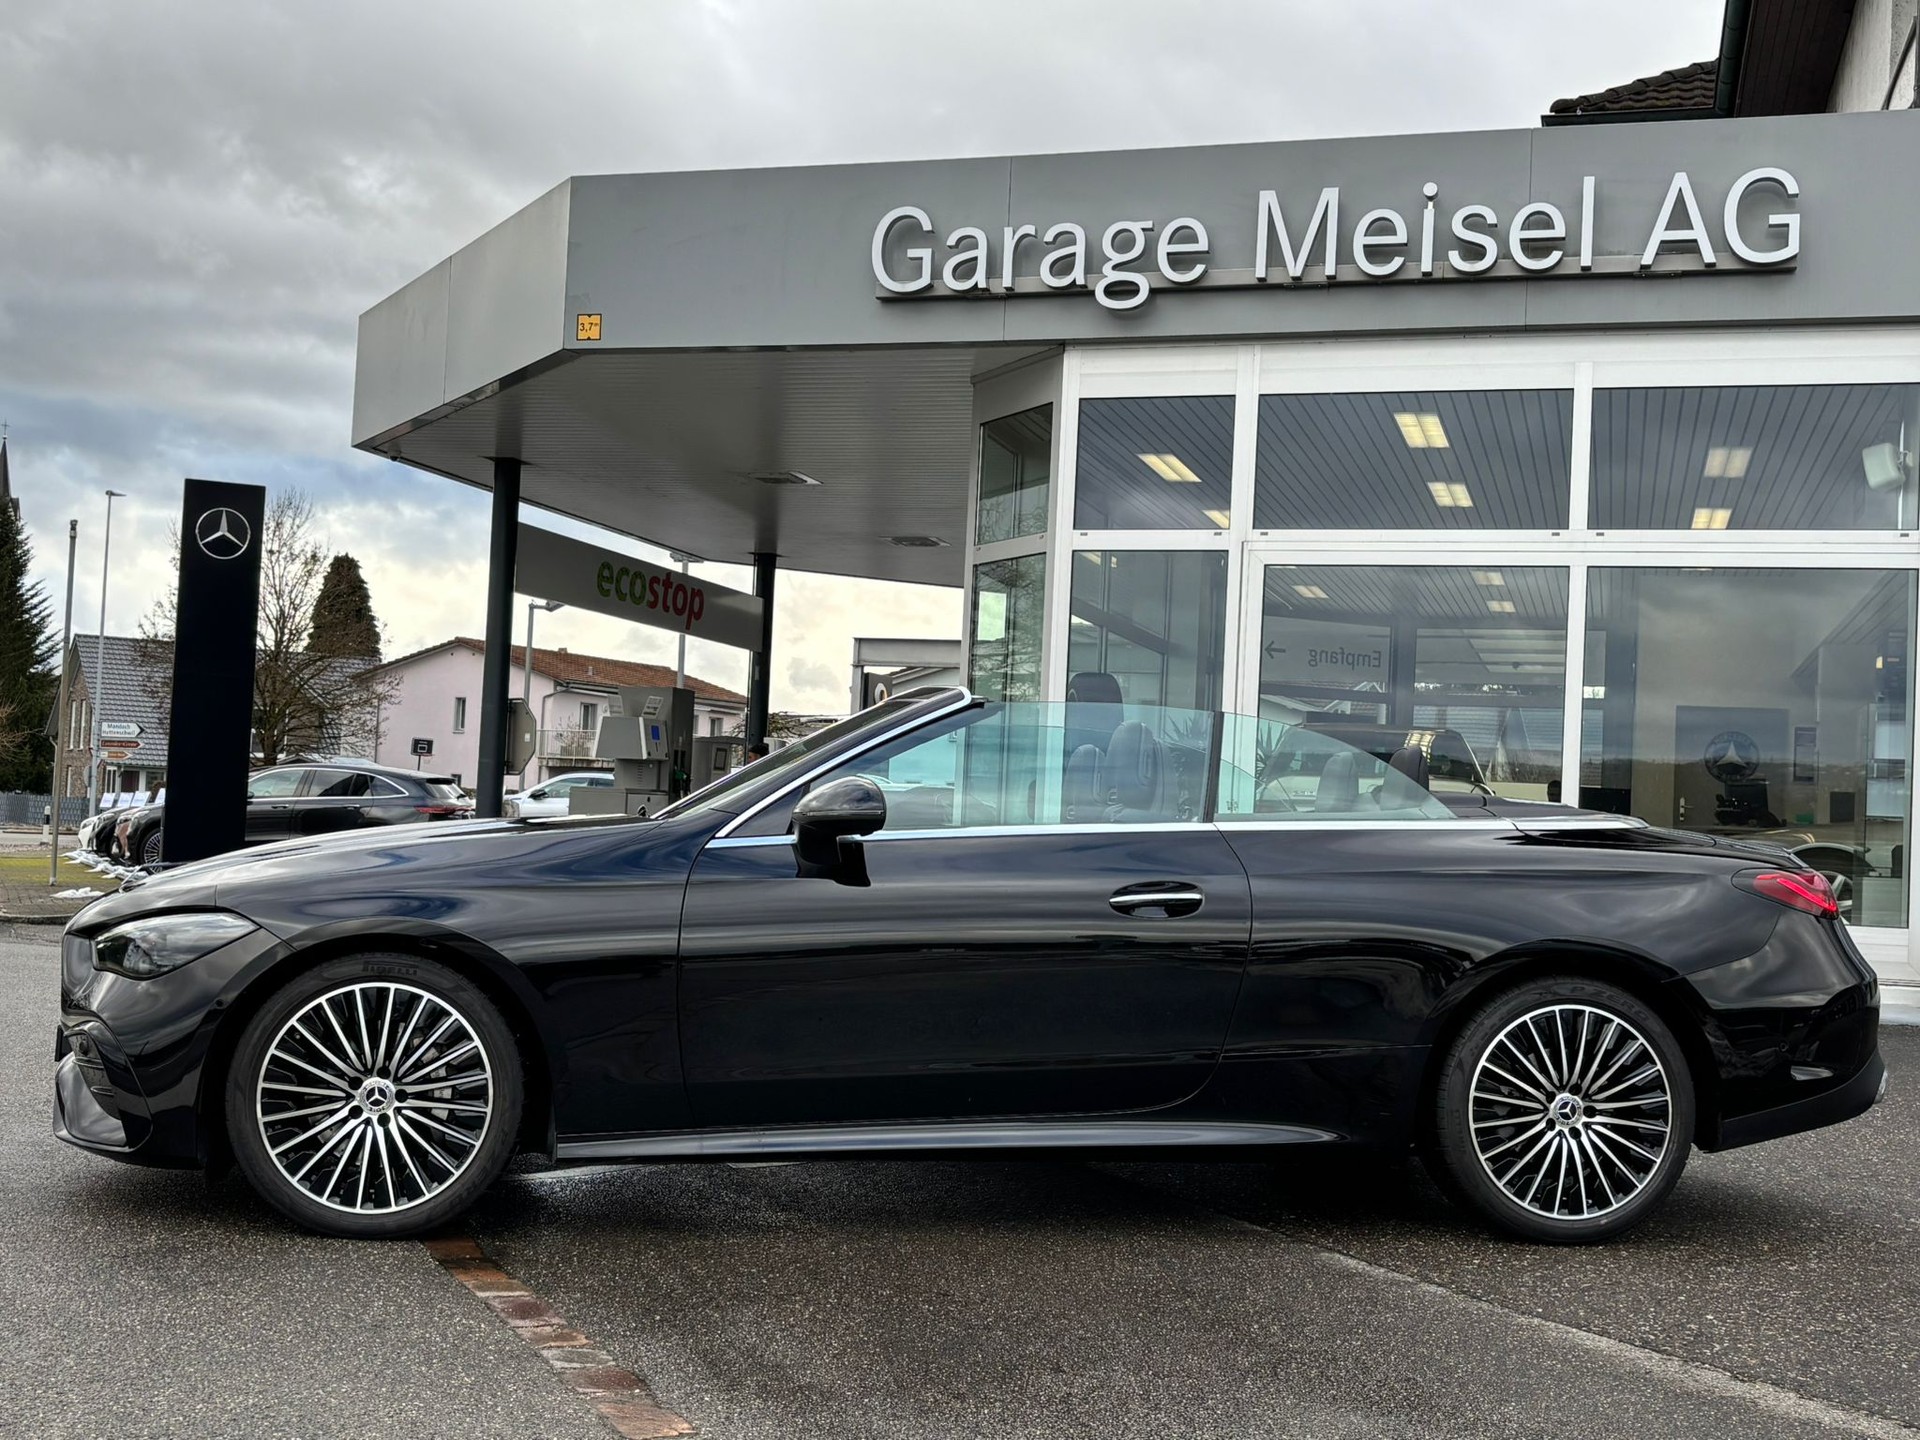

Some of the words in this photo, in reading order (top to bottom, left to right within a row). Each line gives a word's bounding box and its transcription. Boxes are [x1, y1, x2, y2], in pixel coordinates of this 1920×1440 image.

[871, 206, 1209, 309] Garage
[1254, 175, 1596, 280] Meisel
[1640, 167, 1802, 266] AG
[597, 561, 704, 631] ecostop
